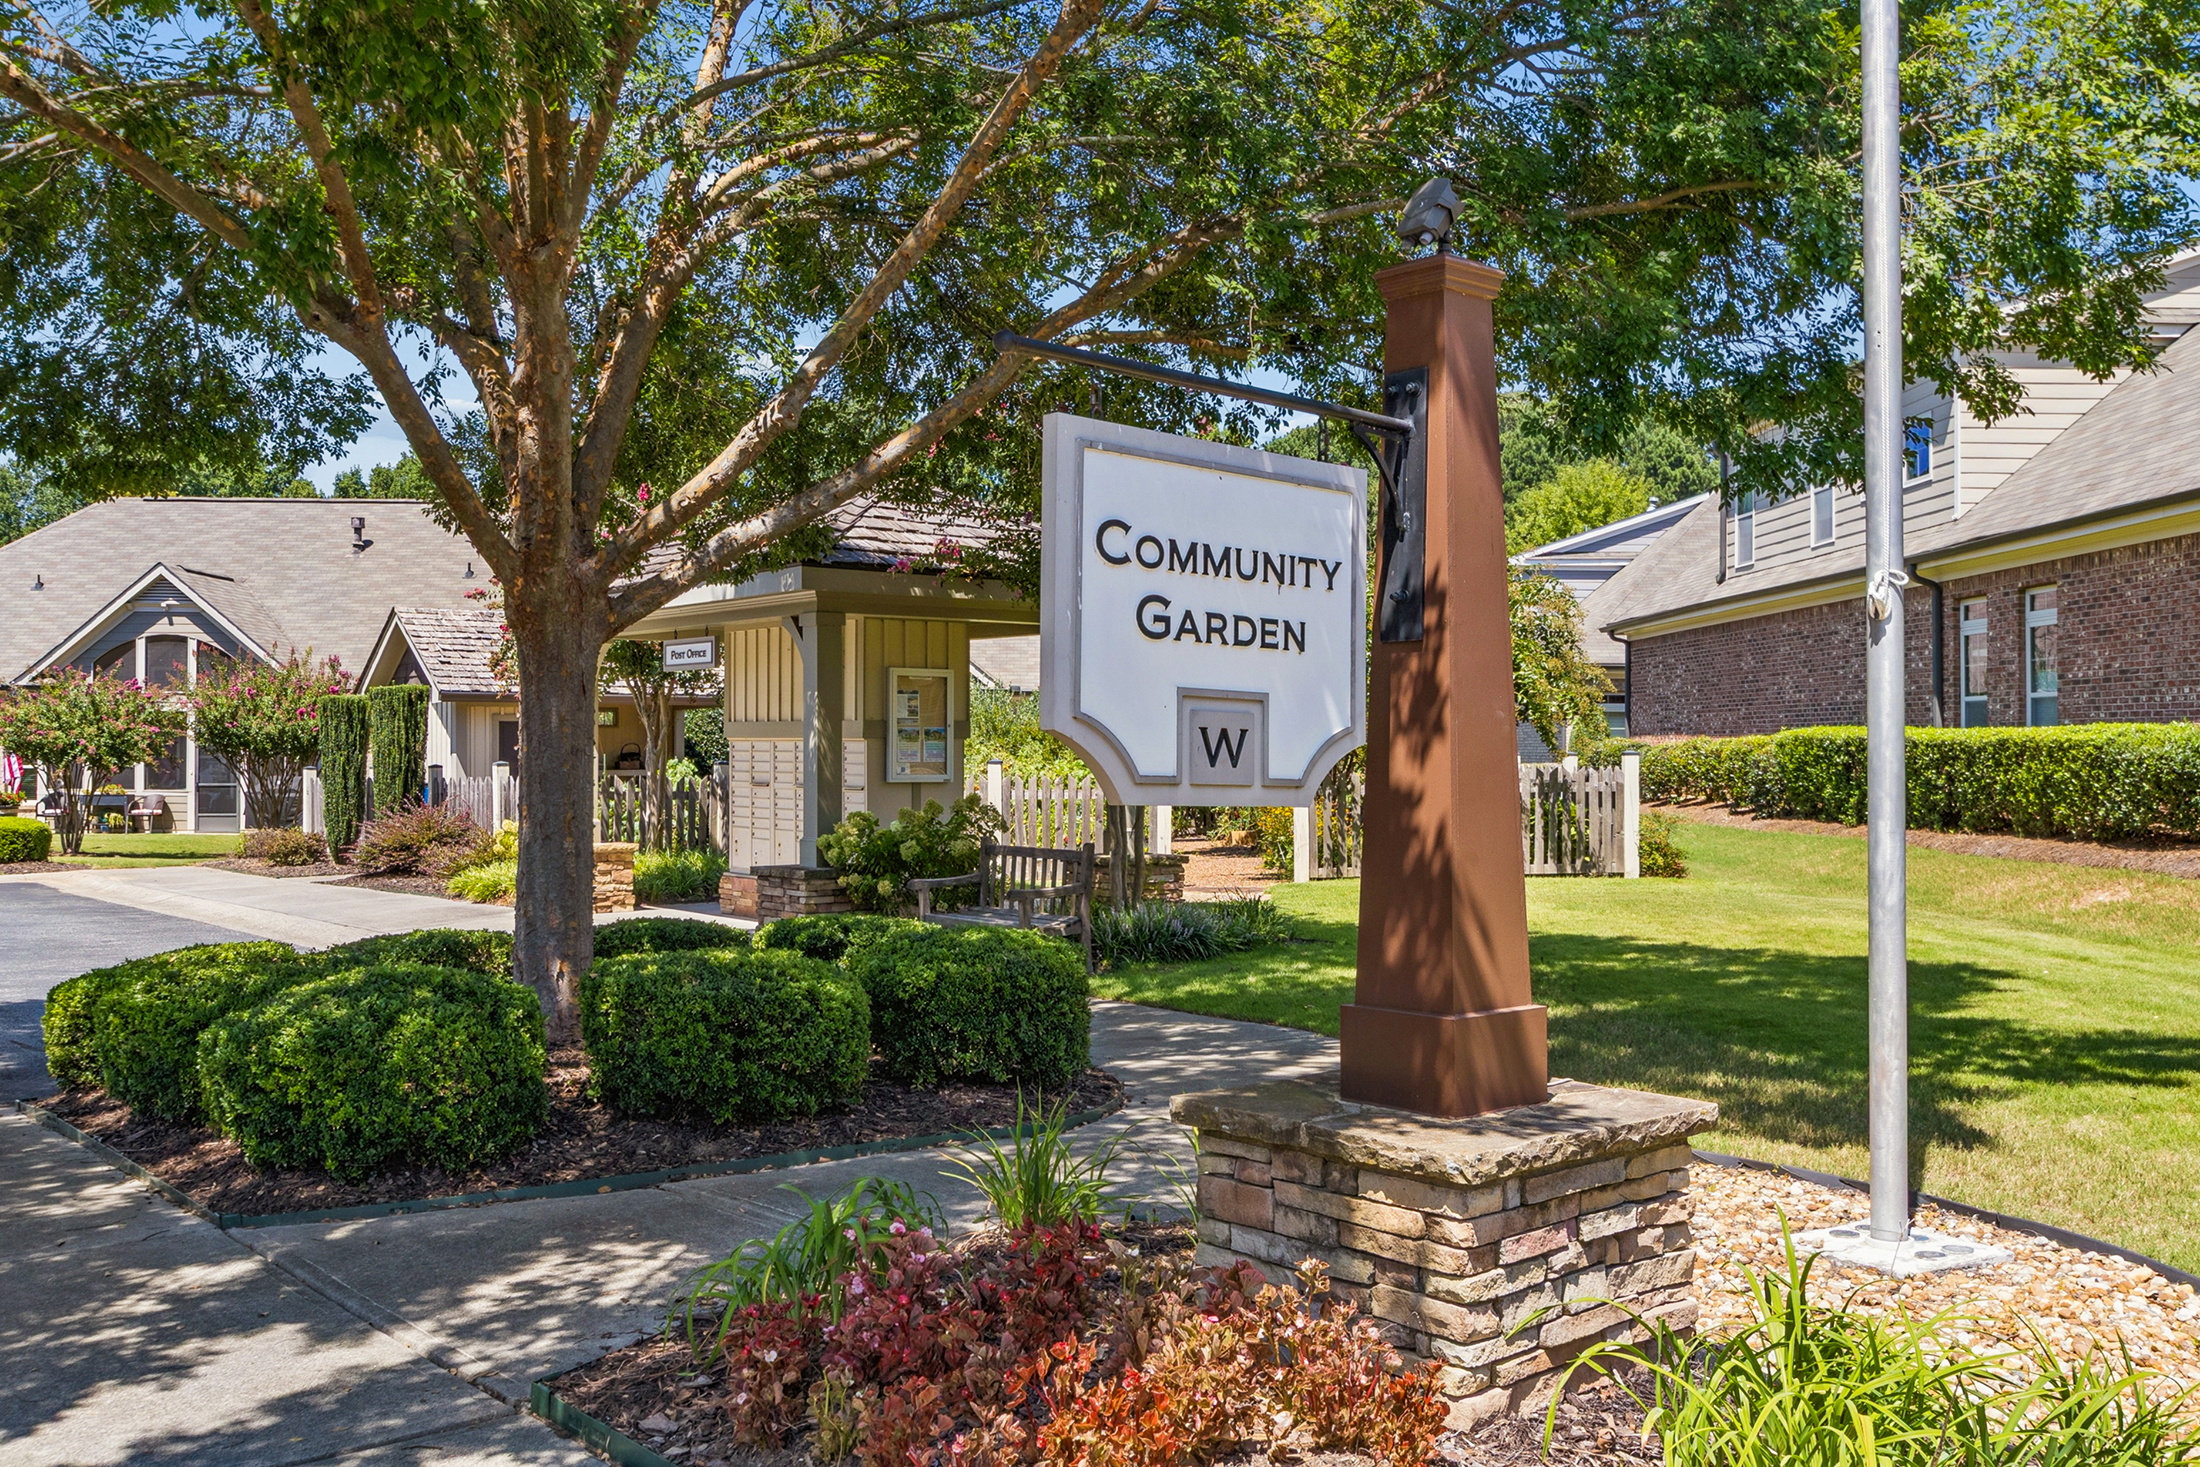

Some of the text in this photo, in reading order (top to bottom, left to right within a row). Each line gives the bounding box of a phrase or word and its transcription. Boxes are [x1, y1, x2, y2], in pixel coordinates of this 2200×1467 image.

[1095, 518, 1342, 591] COMMUNITY
[1135, 594, 1307, 653] GARDEN
[671, 649, 706, 660] POST OFFICE
[1198, 726, 1249, 768] W
